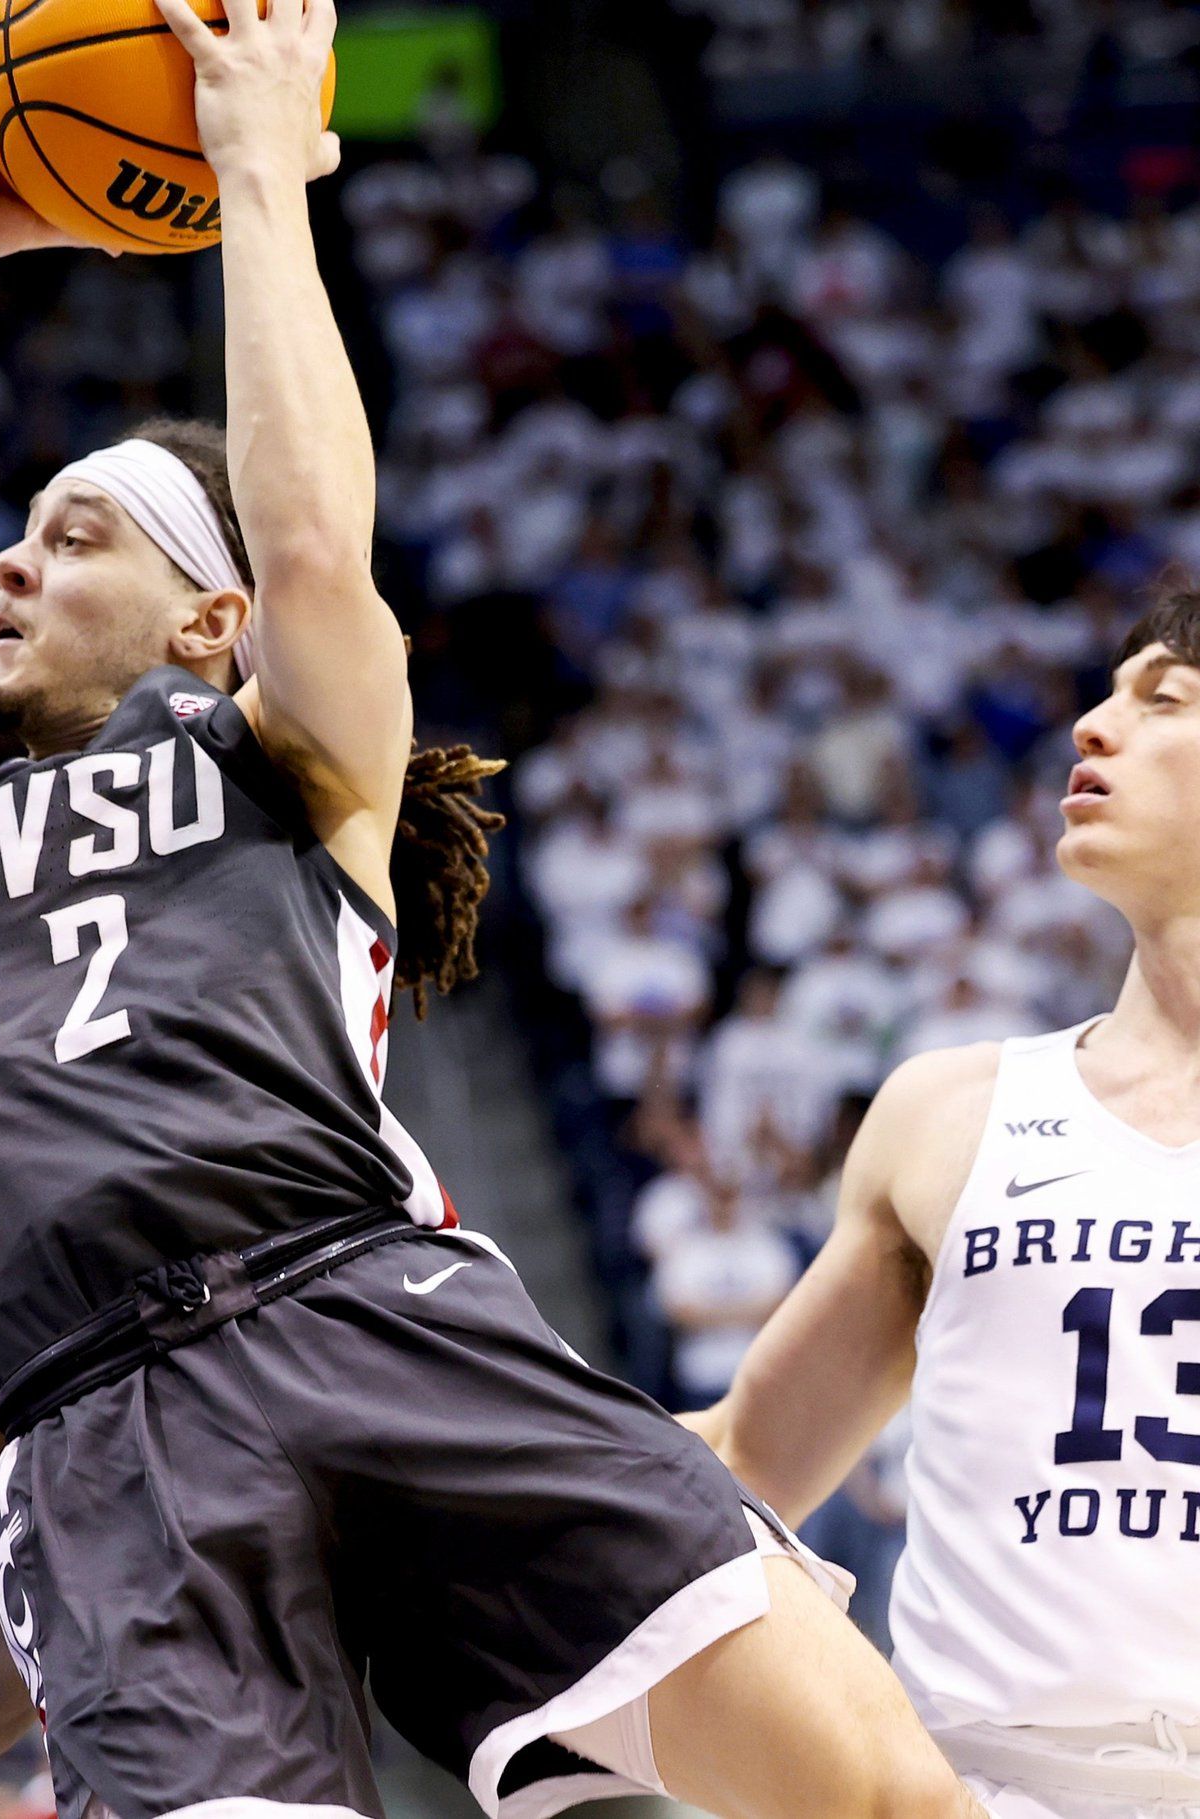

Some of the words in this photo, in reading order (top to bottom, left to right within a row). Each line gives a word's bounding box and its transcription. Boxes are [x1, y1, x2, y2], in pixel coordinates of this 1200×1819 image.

[105, 158, 221, 232] Wil
[40, 894, 131, 1064] 2
[1004, 1118, 1069, 1137] WCC
[1054, 1287, 1200, 1465] 13
